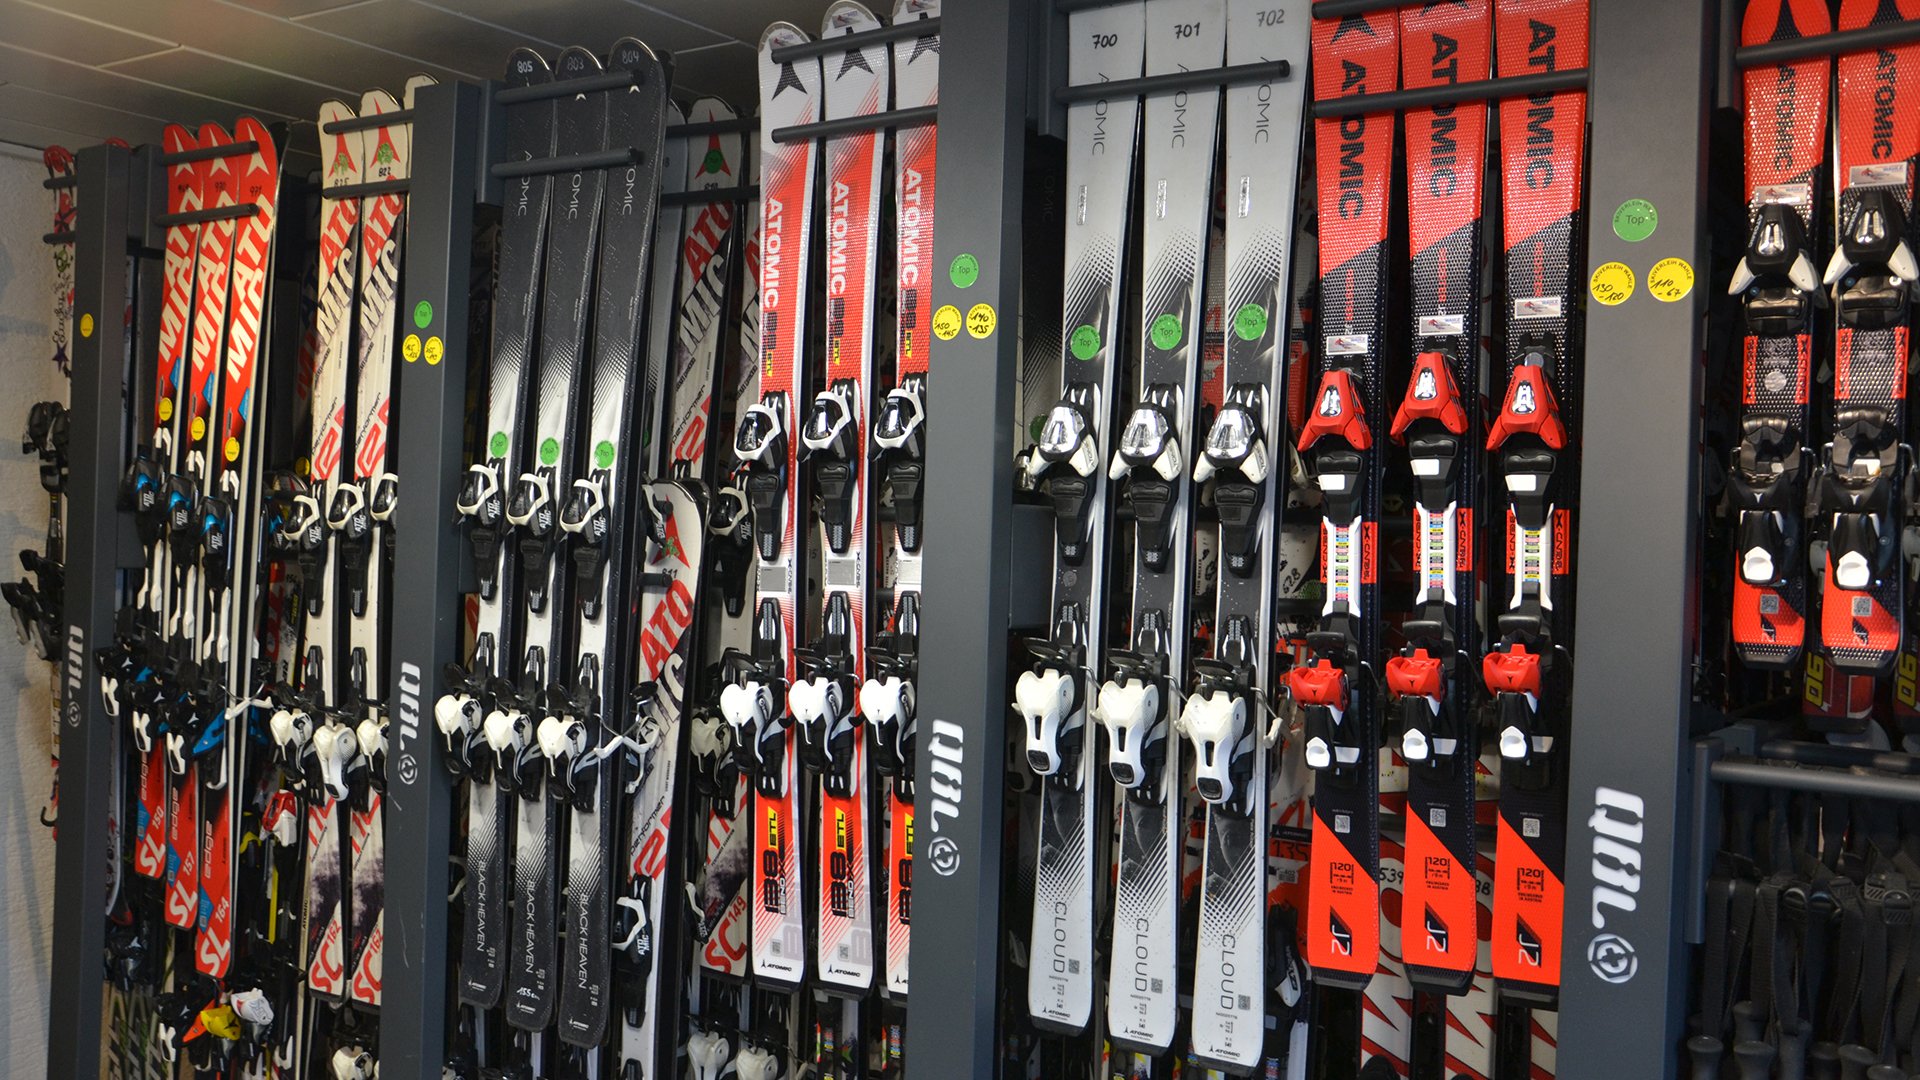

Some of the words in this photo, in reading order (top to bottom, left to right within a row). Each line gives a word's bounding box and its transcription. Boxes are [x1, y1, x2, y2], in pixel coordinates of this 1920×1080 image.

[1174, 22, 1201, 39] 701
[1256, 9, 1285, 27] 702
[622, 50, 640, 64] 804
[1092, 34, 1118, 49] 700
[516, 60, 534, 74] 805
[566, 56, 584, 71] 803
[1092, 72, 1110, 156] AOMIC
[1773, 63, 1796, 173] ATOMIC
[1872, 50, 1897, 160] ATOMIC
[518, 150, 533, 216] AOMIC
[901, 167, 922, 286] ATOMIC
[1625, 214, 1645, 226] Top
[1845, 201, 1862, 236] ATOMIC
[764, 197, 783, 309] ATOMIC
[831, 181, 850, 296] ATOMIC
[958, 265, 971, 275] Top
[1438, 248, 1447, 303] REDSTER
[1533, 241, 1544, 297] REDSTER
[1593, 264, 1624, 283] SKIVERLEIH
[1623, 269, 1633, 289] WAHLE
[1650, 260, 1678, 284] SKIVERLEIH
[1678, 262, 1693, 280] WAHLE
[1650, 279, 1674, 289] 110
[1344, 268, 1354, 322] REDSTER
[1160, 327, 1174, 337] Top
[1243, 317, 1258, 327] Top
[1079, 338, 1092, 348] Top
[671, 384, 707, 445] performer
[640, 579, 695, 681] ATO
[152, 805, 165, 829] 150
[171, 786, 180, 841] edge
[630, 796, 665, 856] performer
[769, 813, 778, 847] ETL
[836, 813, 846, 849] ETL
[140, 833, 166, 877] SL
[182, 851, 195, 876] 157
[203, 820, 214, 879] edge
[1271, 839, 1309, 863] 135
[1427, 857, 1447, 867] 120
[763, 849, 779, 914] 138
[1333, 862, 1351, 872] 120
[1520, 868, 1541, 878] 120
[830, 851, 848, 918] 138
[169, 880, 198, 927] SL
[215, 896, 230, 923] 164
[327, 919, 342, 945] 162
[476, 903, 486, 952] HEAVEN
[705, 918, 748, 974] SC
[728, 896, 748, 922] 149
[1053, 901, 1068, 974] CLOUD
[1331, 924, 1350, 956] J2
[1426, 920, 1446, 952] J2
[200, 926, 231, 977] SL
[525, 923, 535, 974] HEAVEN
[578, 937, 588, 989] HEAVEN
[1134, 917, 1150, 992] CLOUD
[1518, 933, 1539, 966] J2
[311, 942, 344, 994] SC
[767, 964, 793, 972] ATOMIC
[834, 969, 861, 978] ATOMIC
[1220, 933, 1236, 1010] CLOUD
[1048, 1009, 1071, 1018] ATOMIC
[1129, 1029, 1154, 1038] ATOMIC
[1215, 1048, 1241, 1058] ATOMIC
